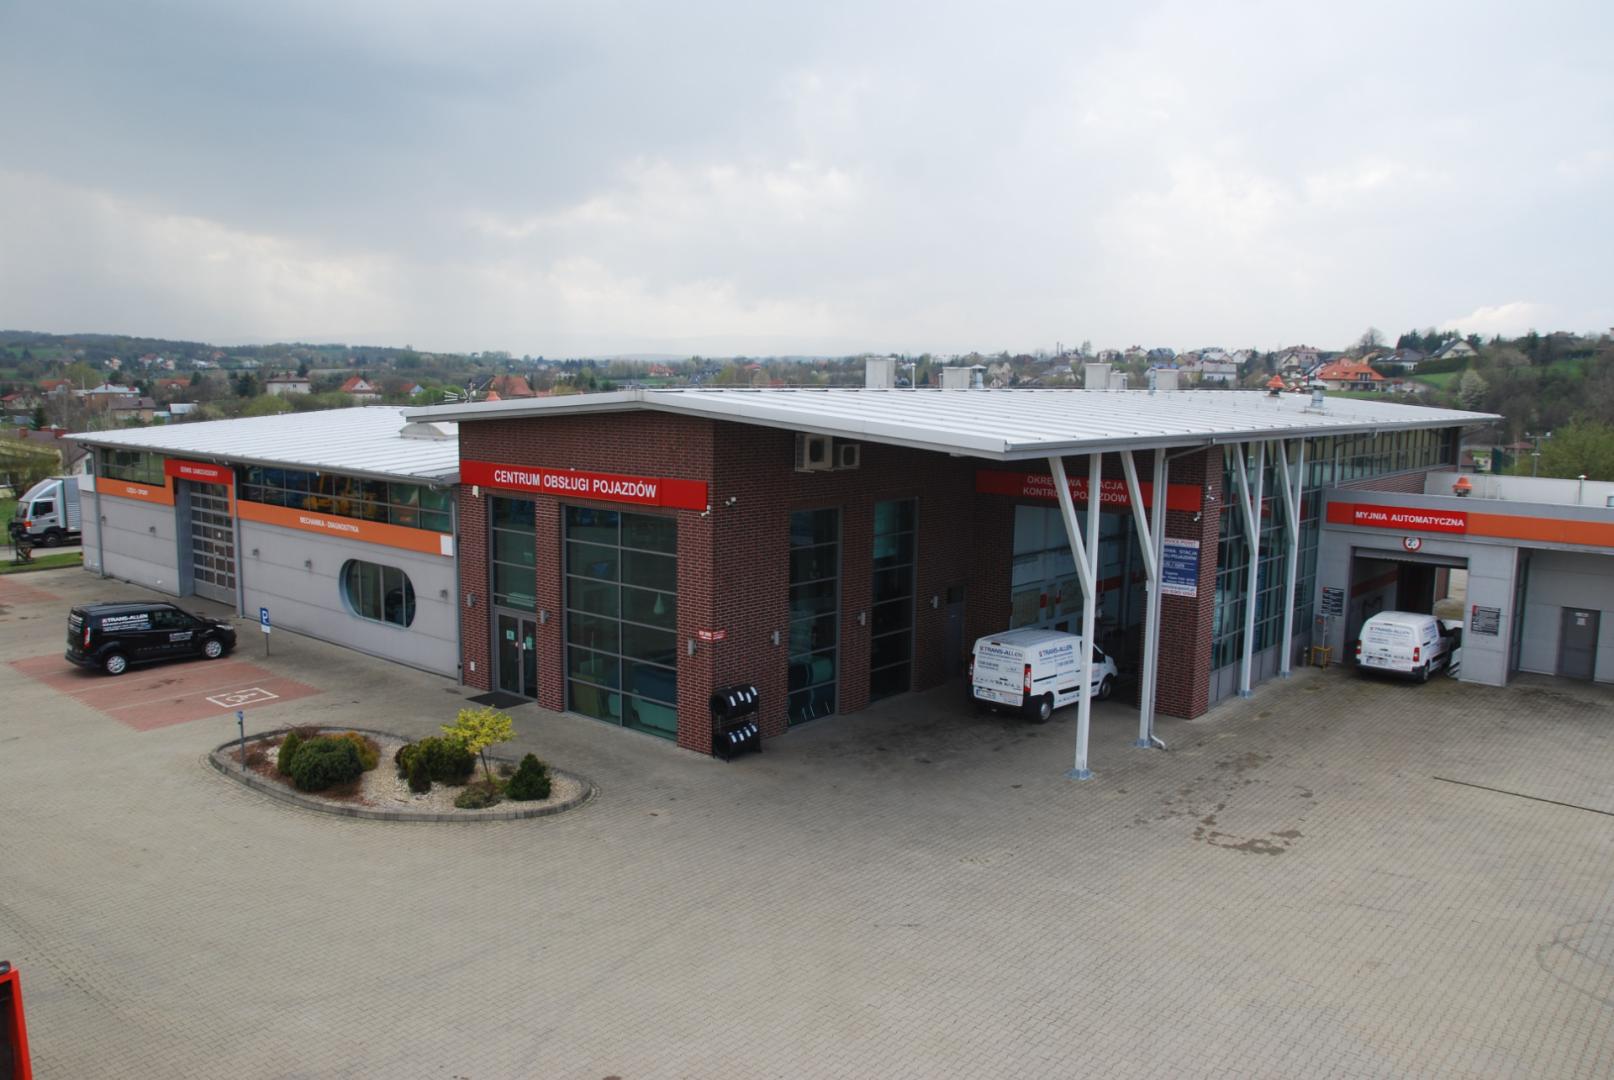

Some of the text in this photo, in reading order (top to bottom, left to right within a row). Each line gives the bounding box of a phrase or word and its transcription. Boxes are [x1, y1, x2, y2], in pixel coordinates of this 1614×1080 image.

[494, 469, 657, 498] CENTRUM OBSŁUGI POJAZDÓW
[1355, 510, 1465, 527] MYJNIA AUTOMATYCZNA
[261, 609, 269, 625] P
